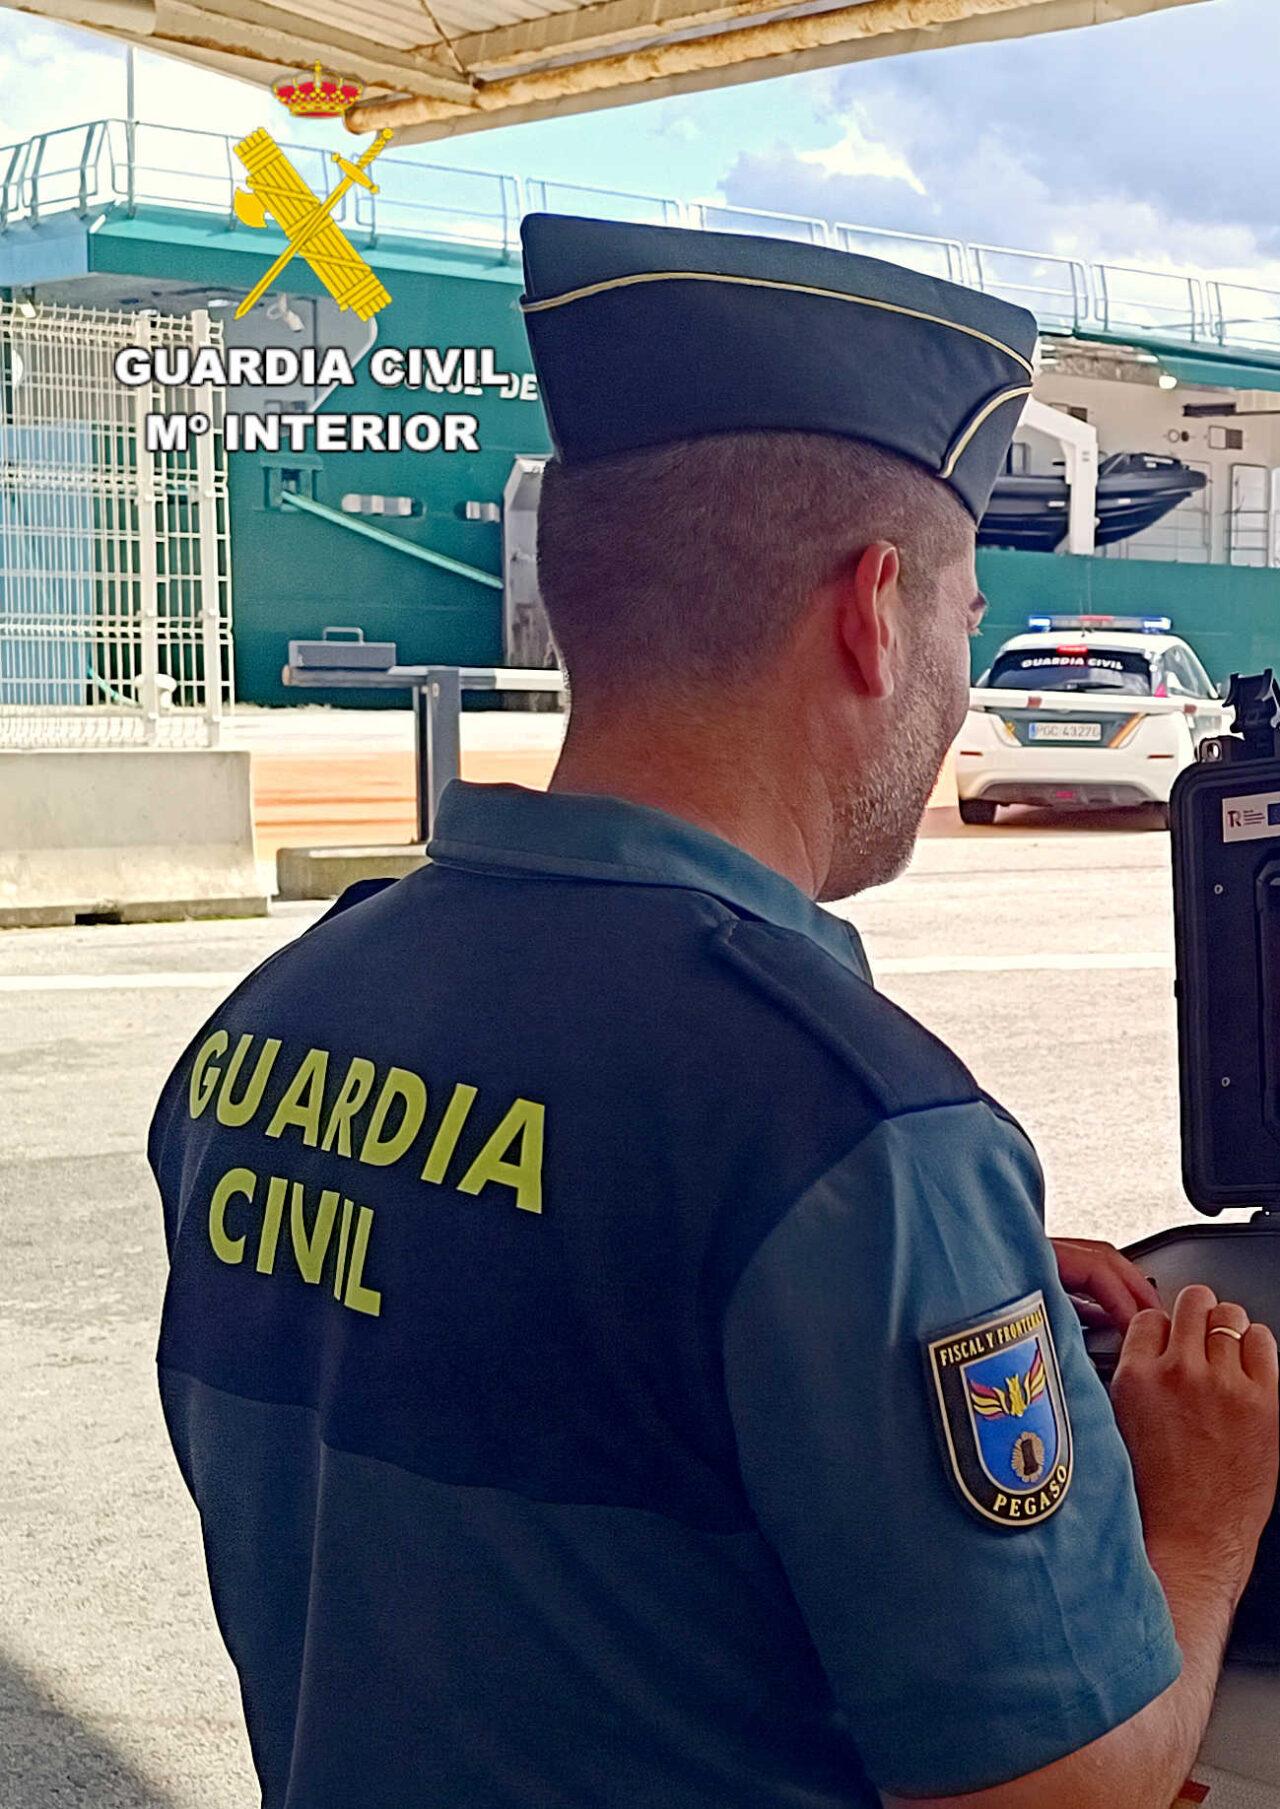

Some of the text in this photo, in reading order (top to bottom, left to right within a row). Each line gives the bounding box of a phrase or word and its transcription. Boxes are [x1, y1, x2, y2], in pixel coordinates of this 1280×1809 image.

[1021, 656, 1124, 671] GUARDIA CIVIL
[189, 1029, 546, 1215] GUARDIA
[208, 1166, 382, 1318] CIVIL
[939, 1336, 985, 1367] FISCAL
[985, 1332, 995, 1350] Y
[992, 1464, 1067, 1518] PEGASO
